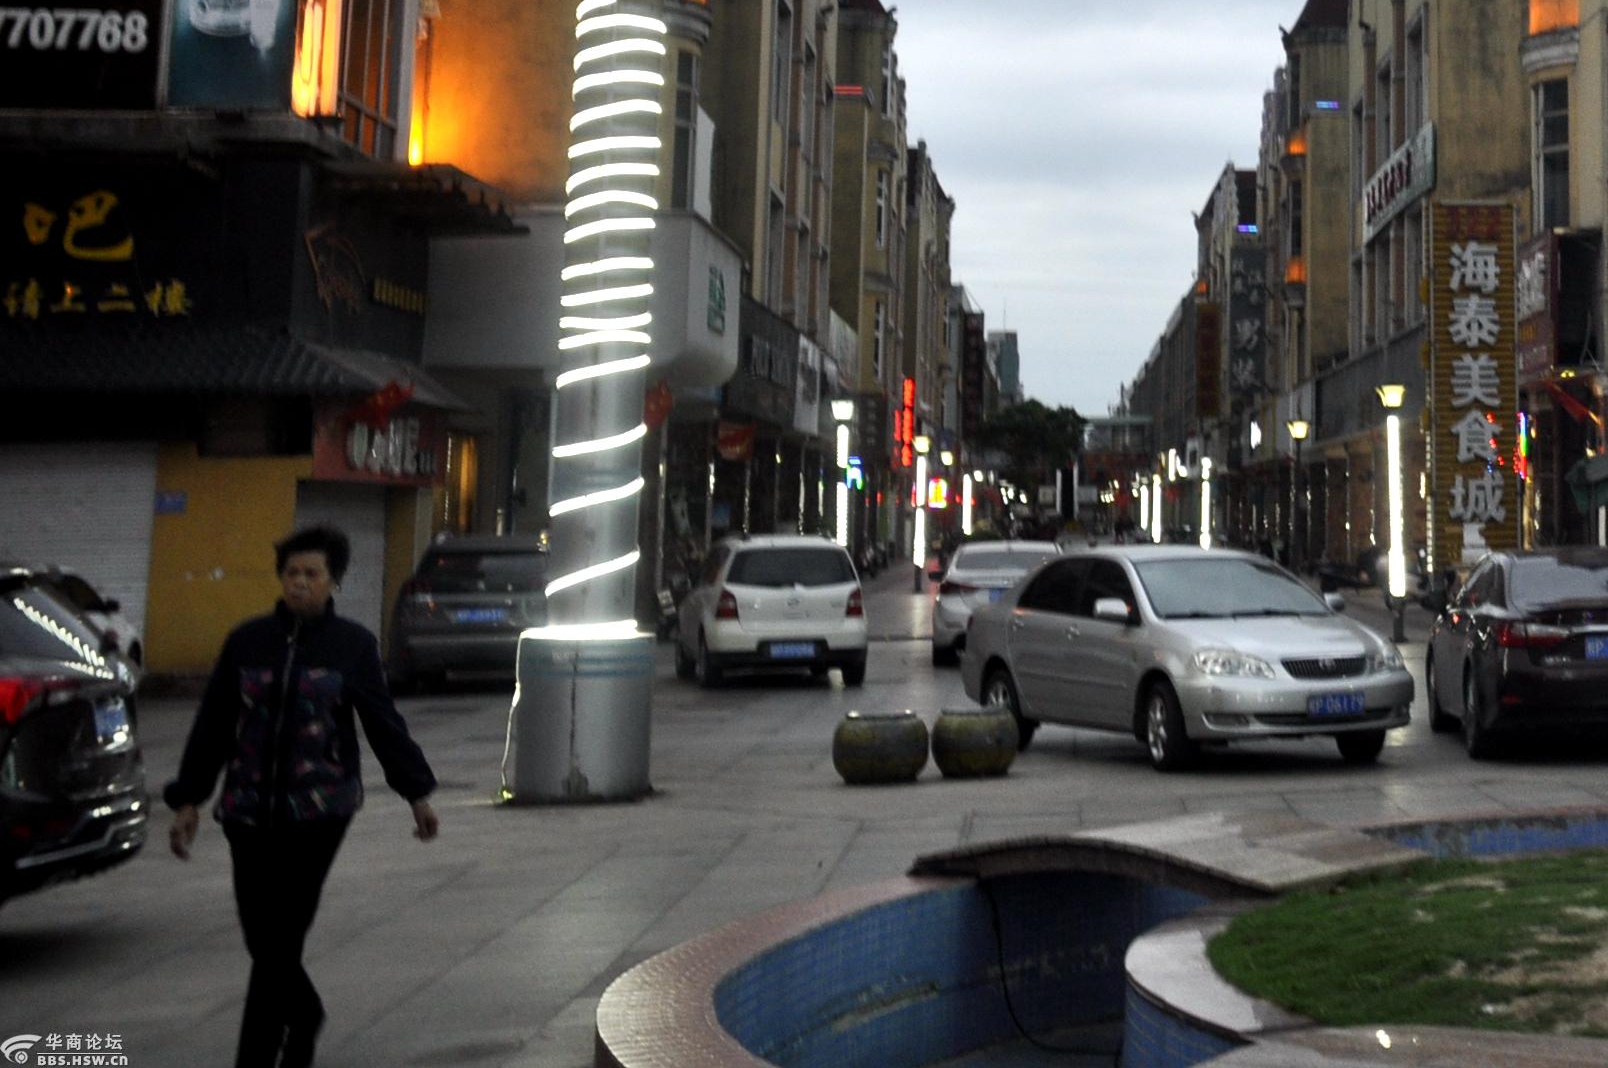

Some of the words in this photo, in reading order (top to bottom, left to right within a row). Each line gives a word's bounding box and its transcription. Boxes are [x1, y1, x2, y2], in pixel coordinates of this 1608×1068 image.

[1448, 239, 1506, 523] 海泰美食城
